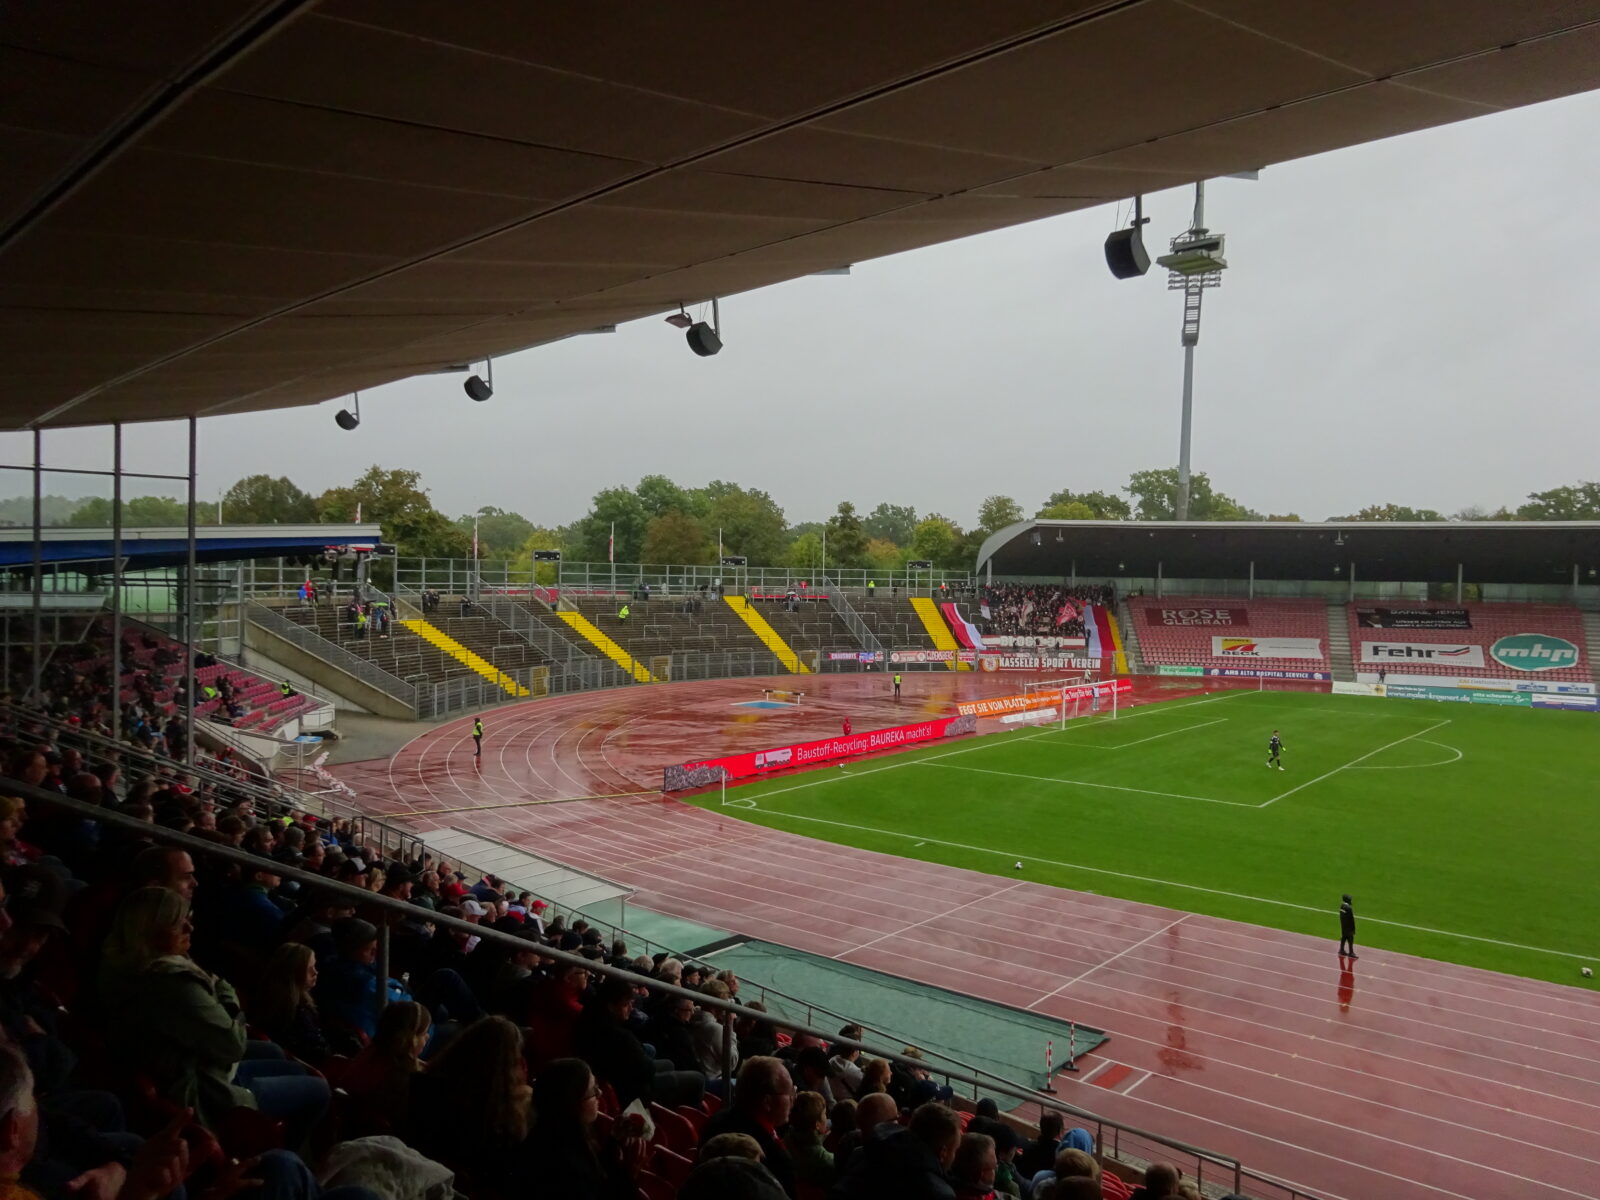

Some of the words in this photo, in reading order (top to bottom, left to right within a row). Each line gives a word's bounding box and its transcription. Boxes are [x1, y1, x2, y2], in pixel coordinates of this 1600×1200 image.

[1162, 609, 1231, 619] ROSE
[1372, 645, 1435, 658] Fehr
[1498, 644, 1574, 662] mhp
[999, 658, 1040, 668] KASSELER
[1041, 658, 1068, 668] SPORT
[1070, 658, 1100, 668] VEREIN
[959, 704, 977, 716] FEGT
[977, 703, 988, 713] SIE
[987, 700, 1005, 711] VOM
[797, 738, 869, 761] Baustoff-Recycling:
[870, 730, 905, 747] BAUREKA
[906, 726, 932, 740] macht's!
